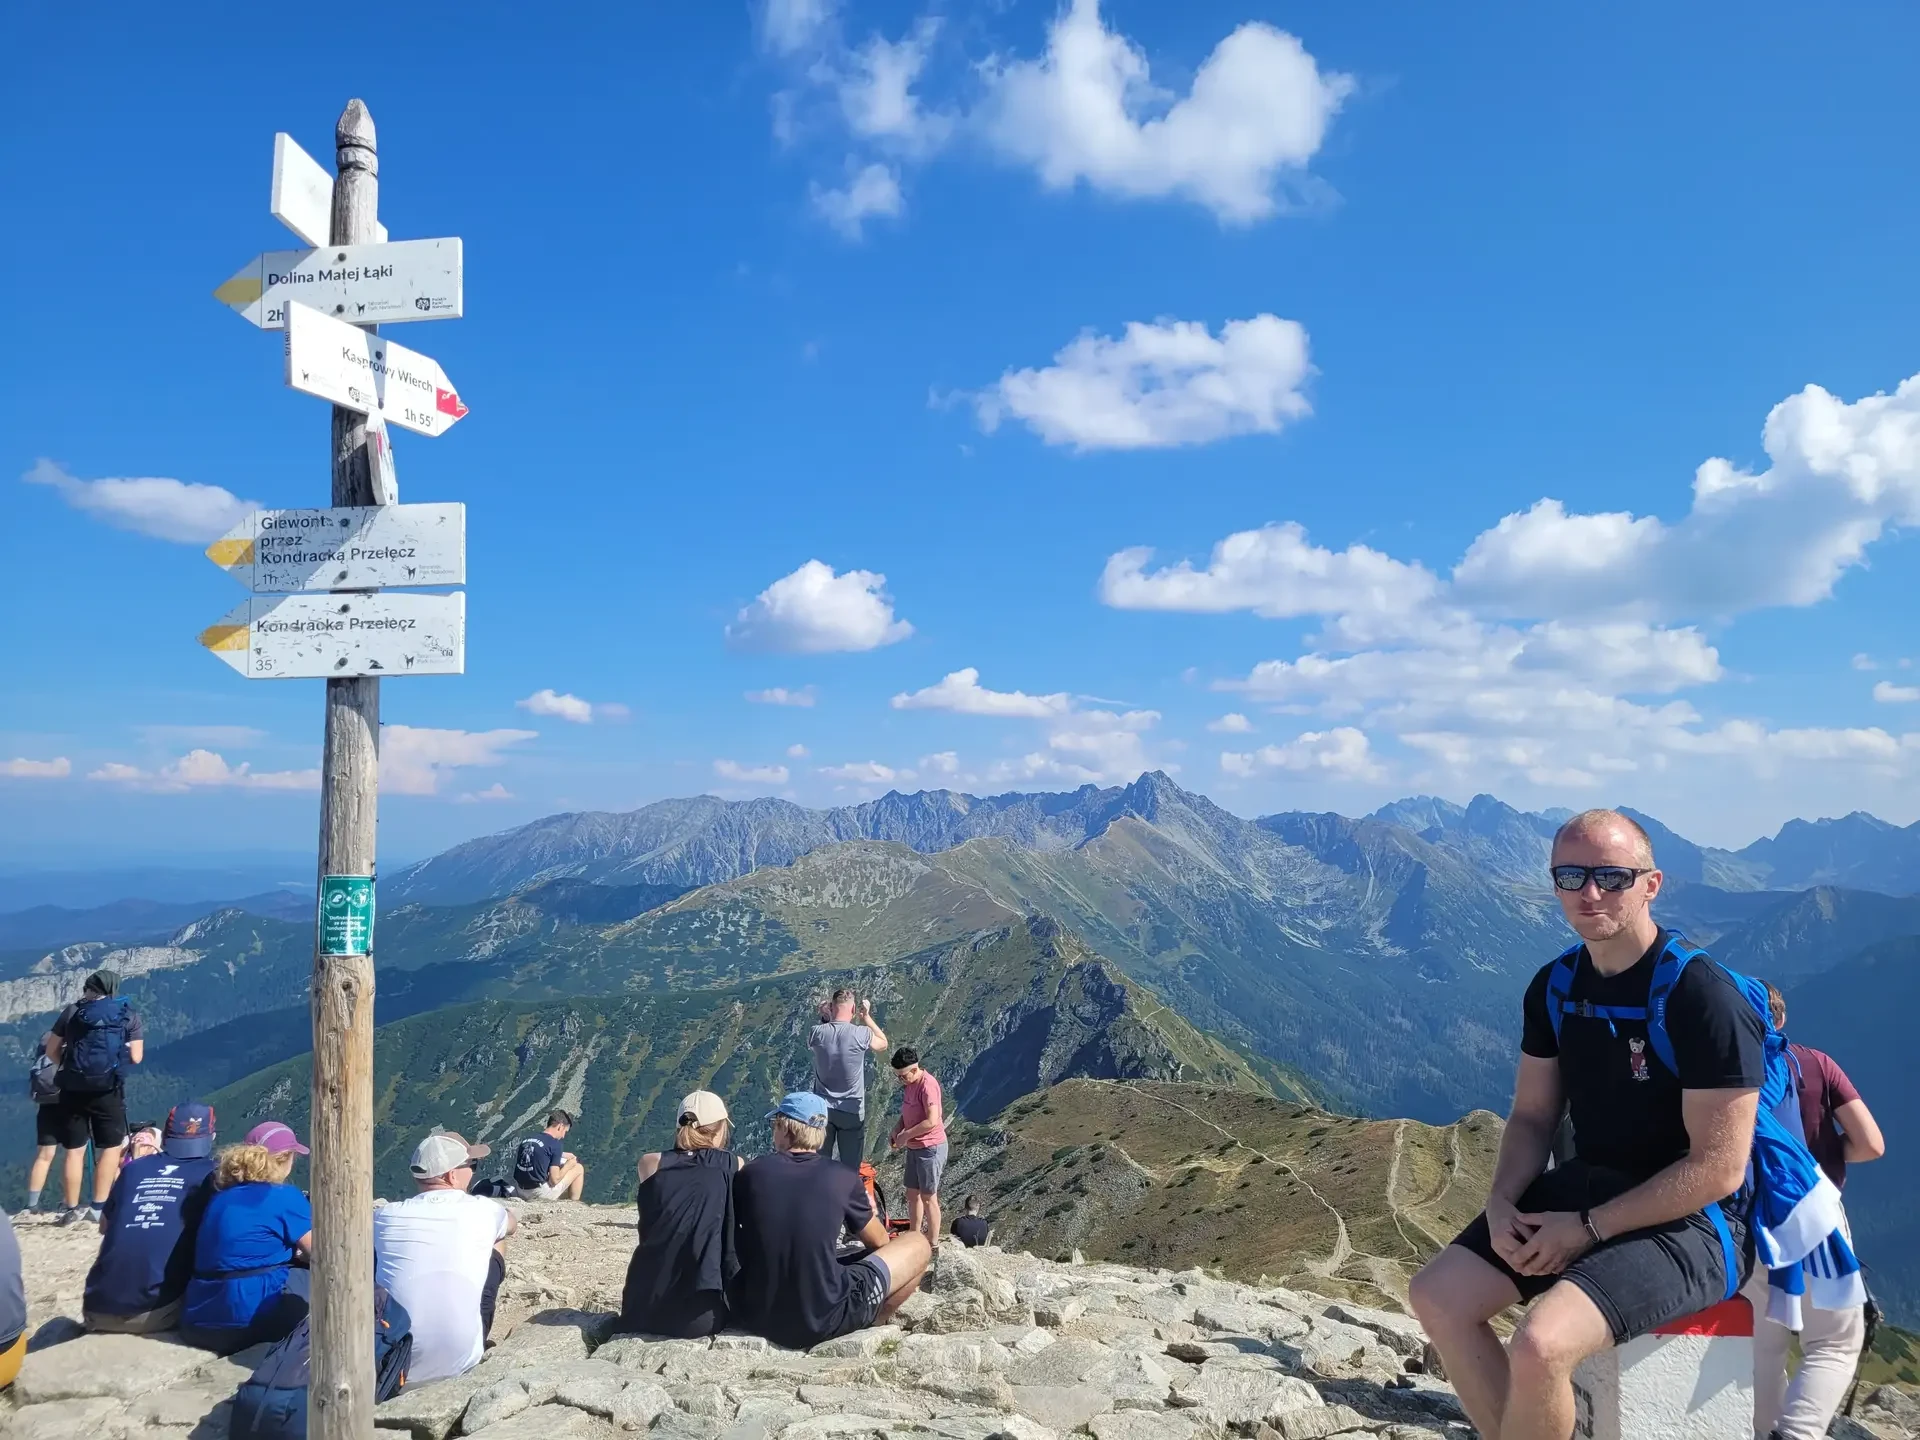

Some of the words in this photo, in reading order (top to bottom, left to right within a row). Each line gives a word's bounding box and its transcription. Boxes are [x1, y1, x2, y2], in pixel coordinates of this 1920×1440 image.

[268, 272, 315, 286] Dolina
[319, 268, 359, 283] Małej
[363, 264, 393, 280] Łąki
[267, 308, 285, 322] 2h
[342, 346, 395, 379] Kasprowy
[398, 368, 433, 393] Wierch
[404, 408, 417, 422] 1h
[261, 515, 326, 530] Giewont
[261, 535, 303, 550] przez
[261, 549, 345, 564] Kondracką
[351, 546, 416, 563] Przełęcz
[257, 618, 344, 633] Kondracka
